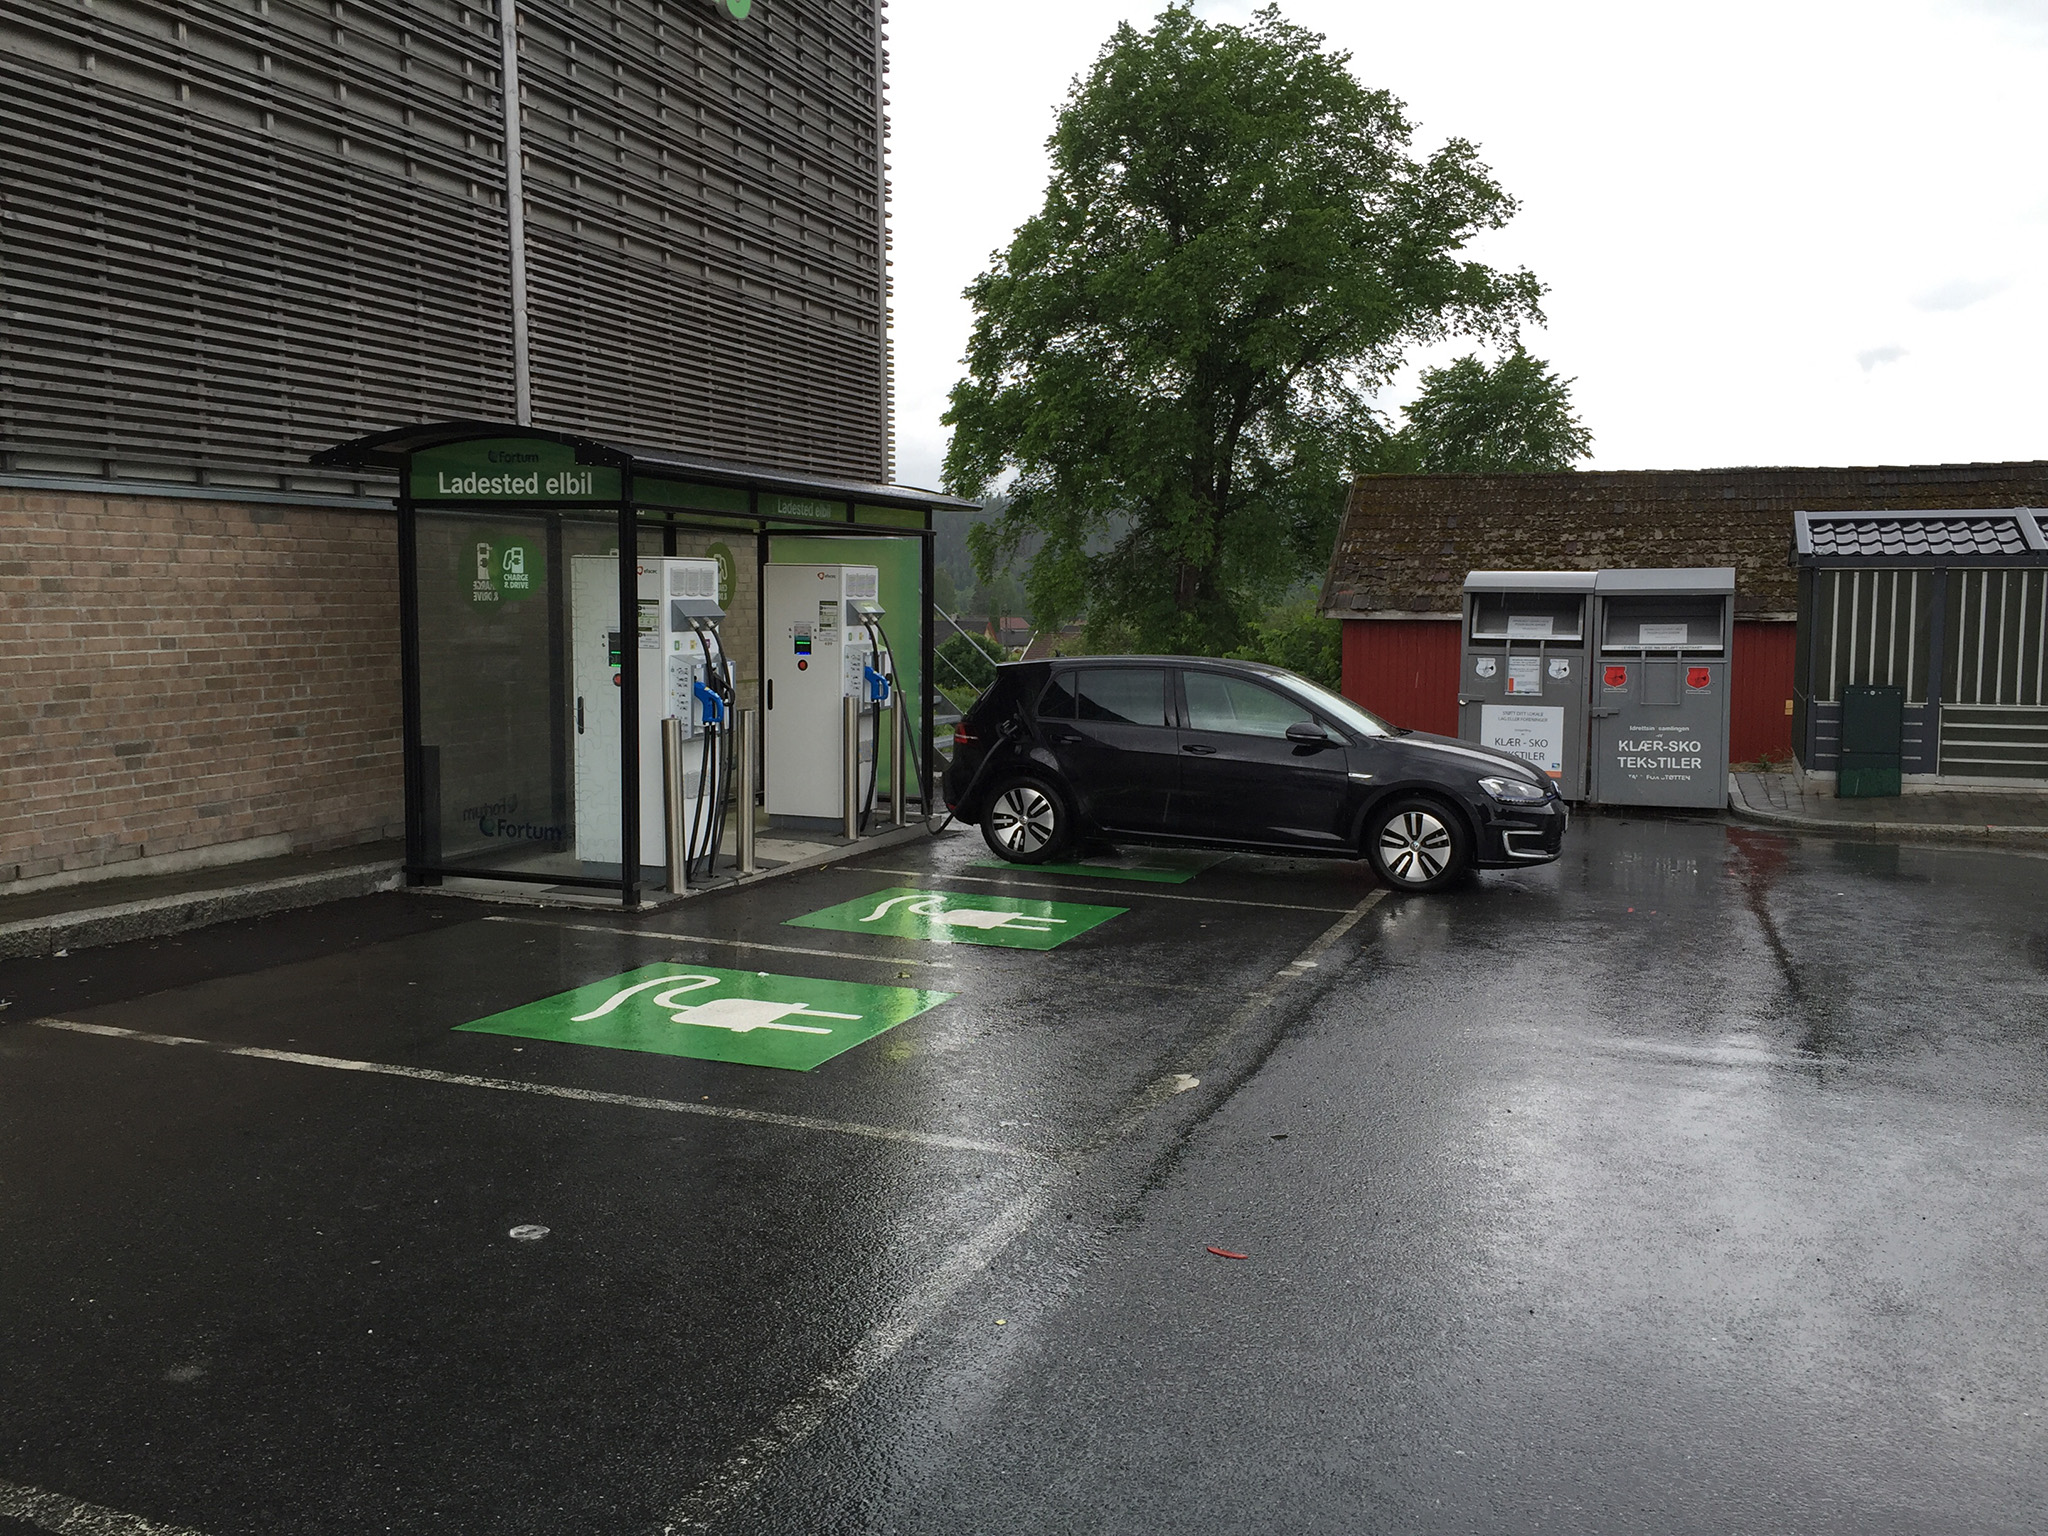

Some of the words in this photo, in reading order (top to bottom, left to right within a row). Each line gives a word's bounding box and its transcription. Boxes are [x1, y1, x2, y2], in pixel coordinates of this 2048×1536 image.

[498, 451, 539, 464] Fortum
[438, 471, 539, 494] Ladested
[545, 471, 593, 495] elbil
[777, 499, 814, 516] Ladested
[503, 573, 529, 582] CHARGE
[504, 581, 509, 589] &
[510, 581, 529, 589] DRIVE
[1494, 737, 1521, 748] KLÆR
[1528, 738, 1549, 749] SKO
[1618, 740, 1702, 753] KLÆR-SKO
[1617, 756, 1702, 769] TEKSTILER
[497, 818, 562, 841] Fortum
